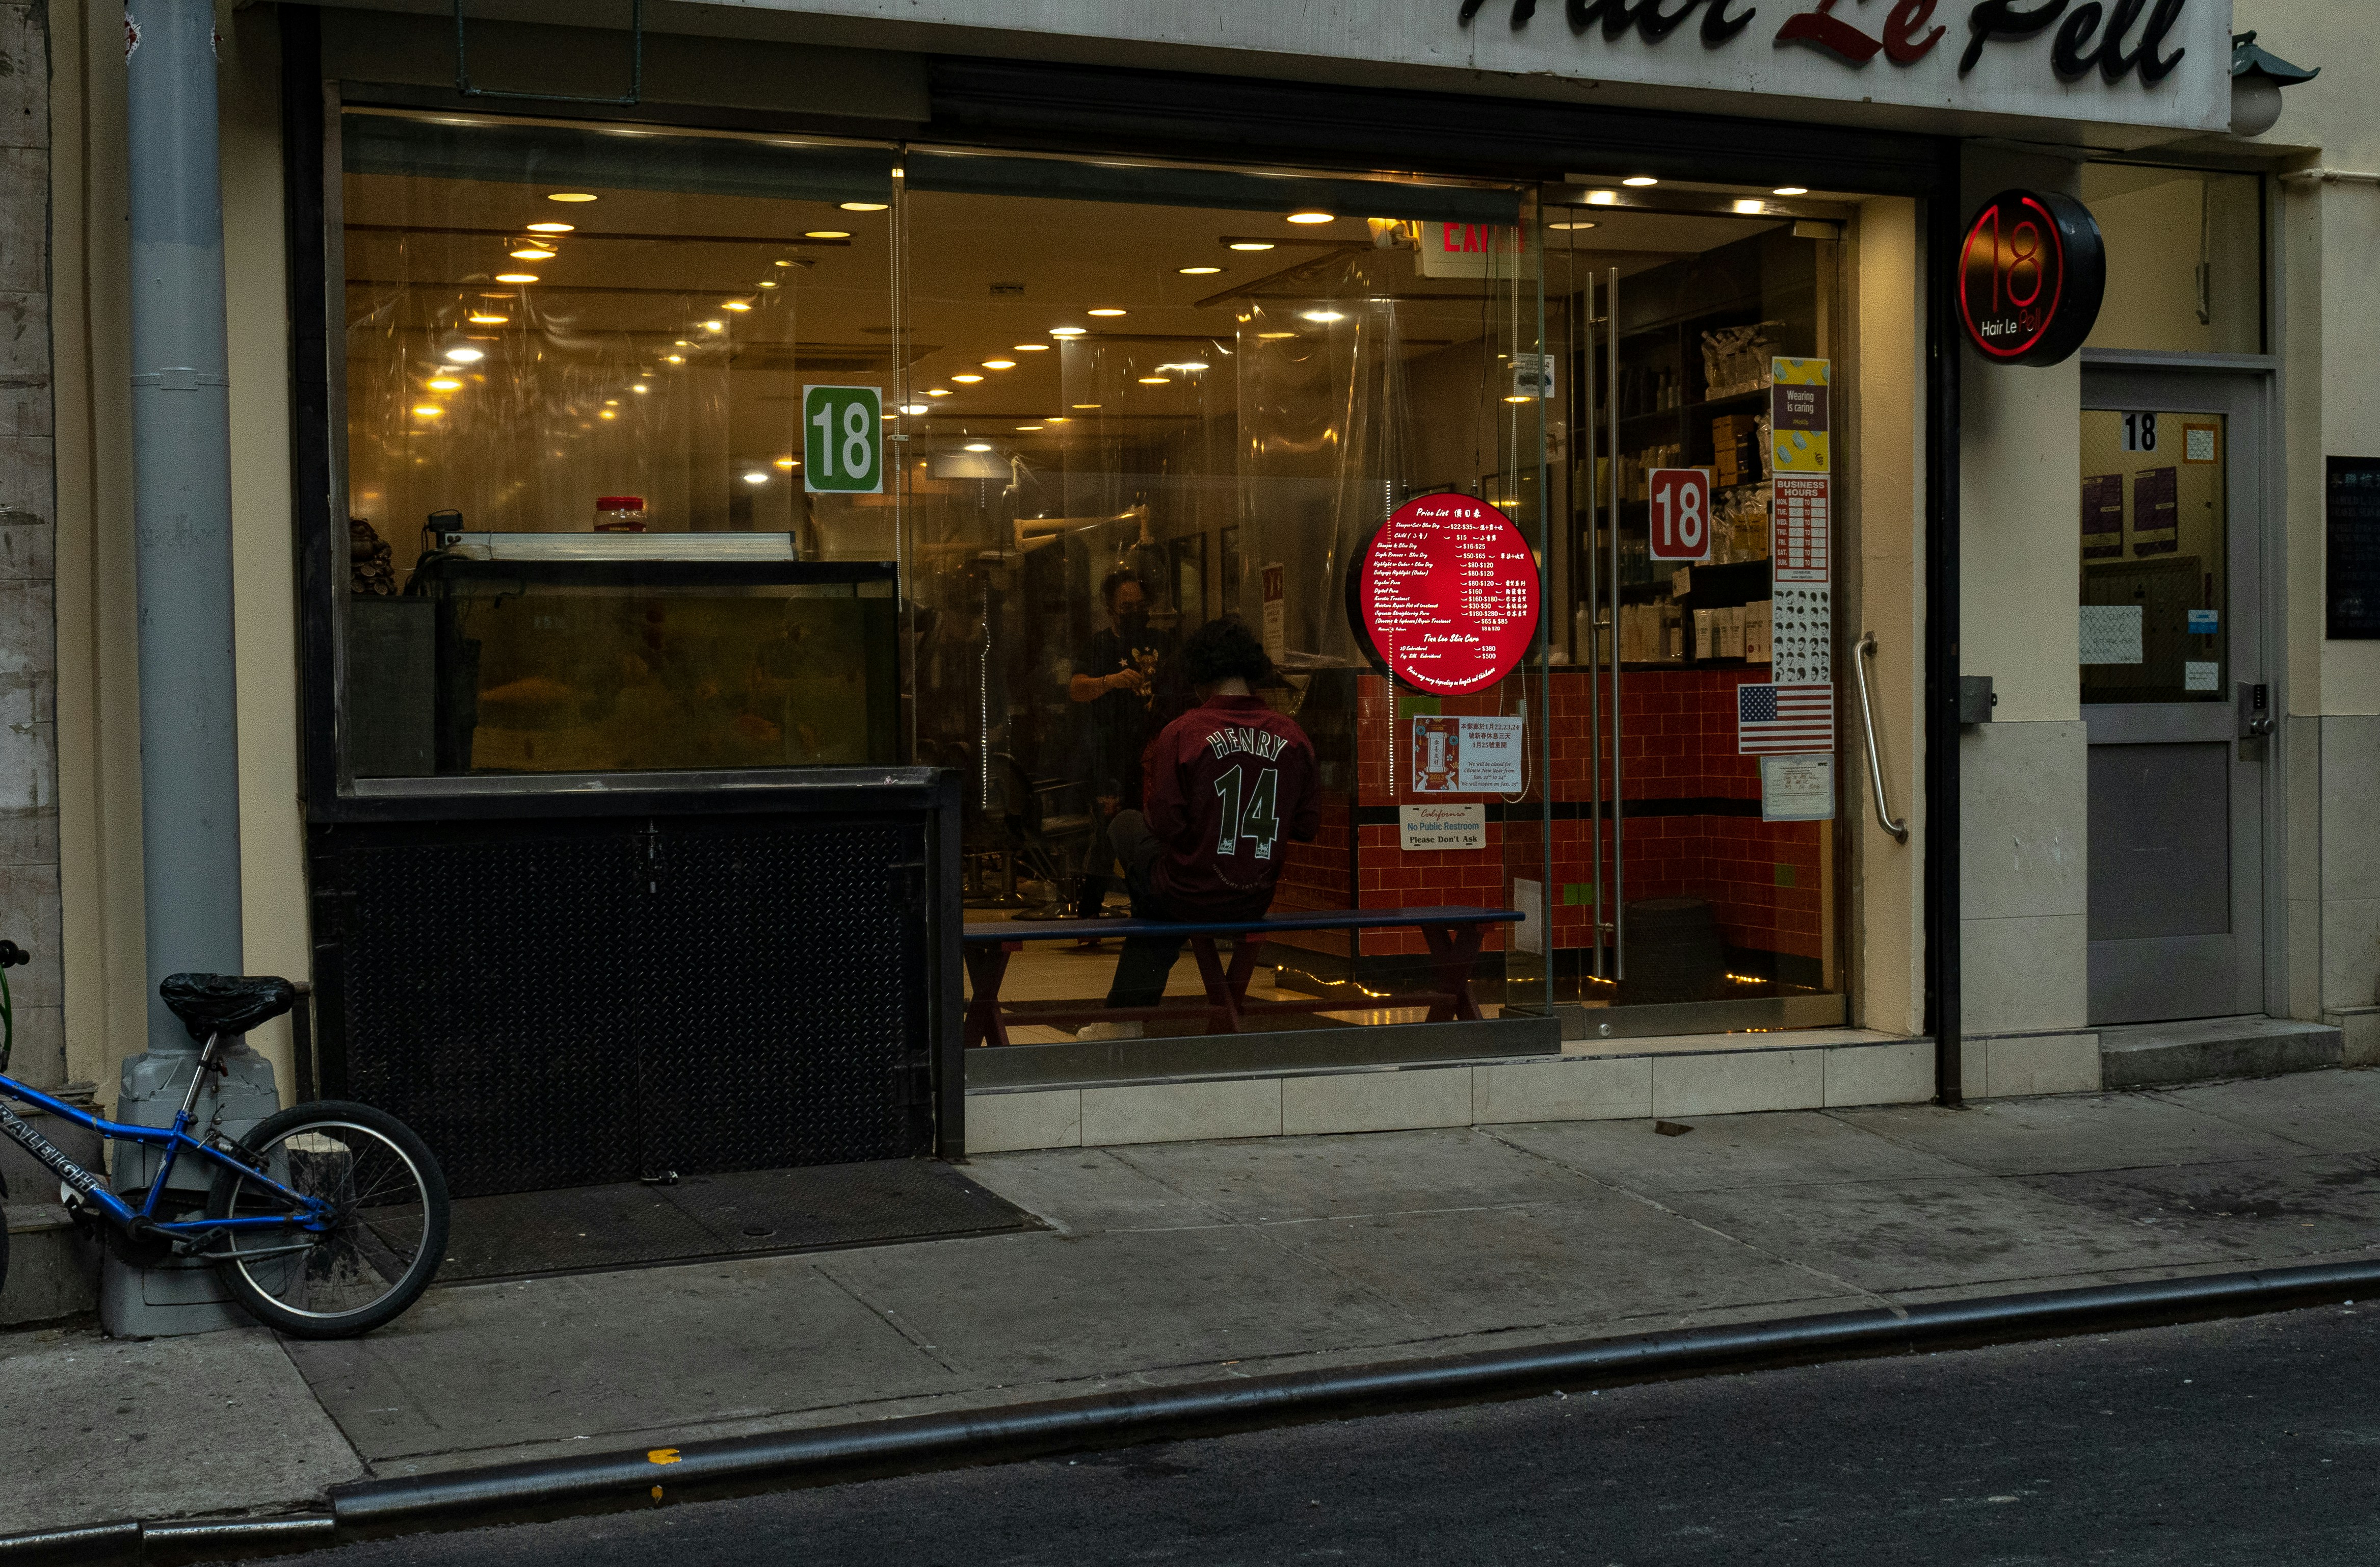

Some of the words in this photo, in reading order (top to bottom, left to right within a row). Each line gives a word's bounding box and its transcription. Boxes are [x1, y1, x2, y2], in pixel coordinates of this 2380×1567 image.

[1443, 222, 1509, 253] EXI
[1981, 204, 2042, 312] 18
[1981, 320, 2003, 337] Hair
[2005, 319, 2017, 334] Le
[2019, 307, 2042, 332] Pell
[1787, 390, 1814, 402] Wearing
[1787, 402, 1793, 411] is
[1794, 403, 1814, 414] caring
[813, 401, 871, 480] 18
[2126, 413, 2155, 451] 18
[1777, 481, 1824, 489] BUSINESS
[1416, 508, 1434, 516] Price
[1656, 481, 1702, 548] 18
[1424, 634, 1436, 642] Tina
[1449, 634, 1463, 642] Skin
[1465, 634, 1479, 642] Care
[1407, 666, 1417, 676] Price
[1435, 678, 1453, 688] depending
[1459, 677, 1471, 687] length
[1206, 727, 1288, 762] HENRY
[1214, 764, 1279, 860] 14
[1408, 823, 1418, 831] No
[1420, 822, 1442, 830] Public
[1444, 822, 1479, 830] Restroom
[1421, 808, 1466, 821] California
[0, 1104, 100, 1192] RALEIGH
